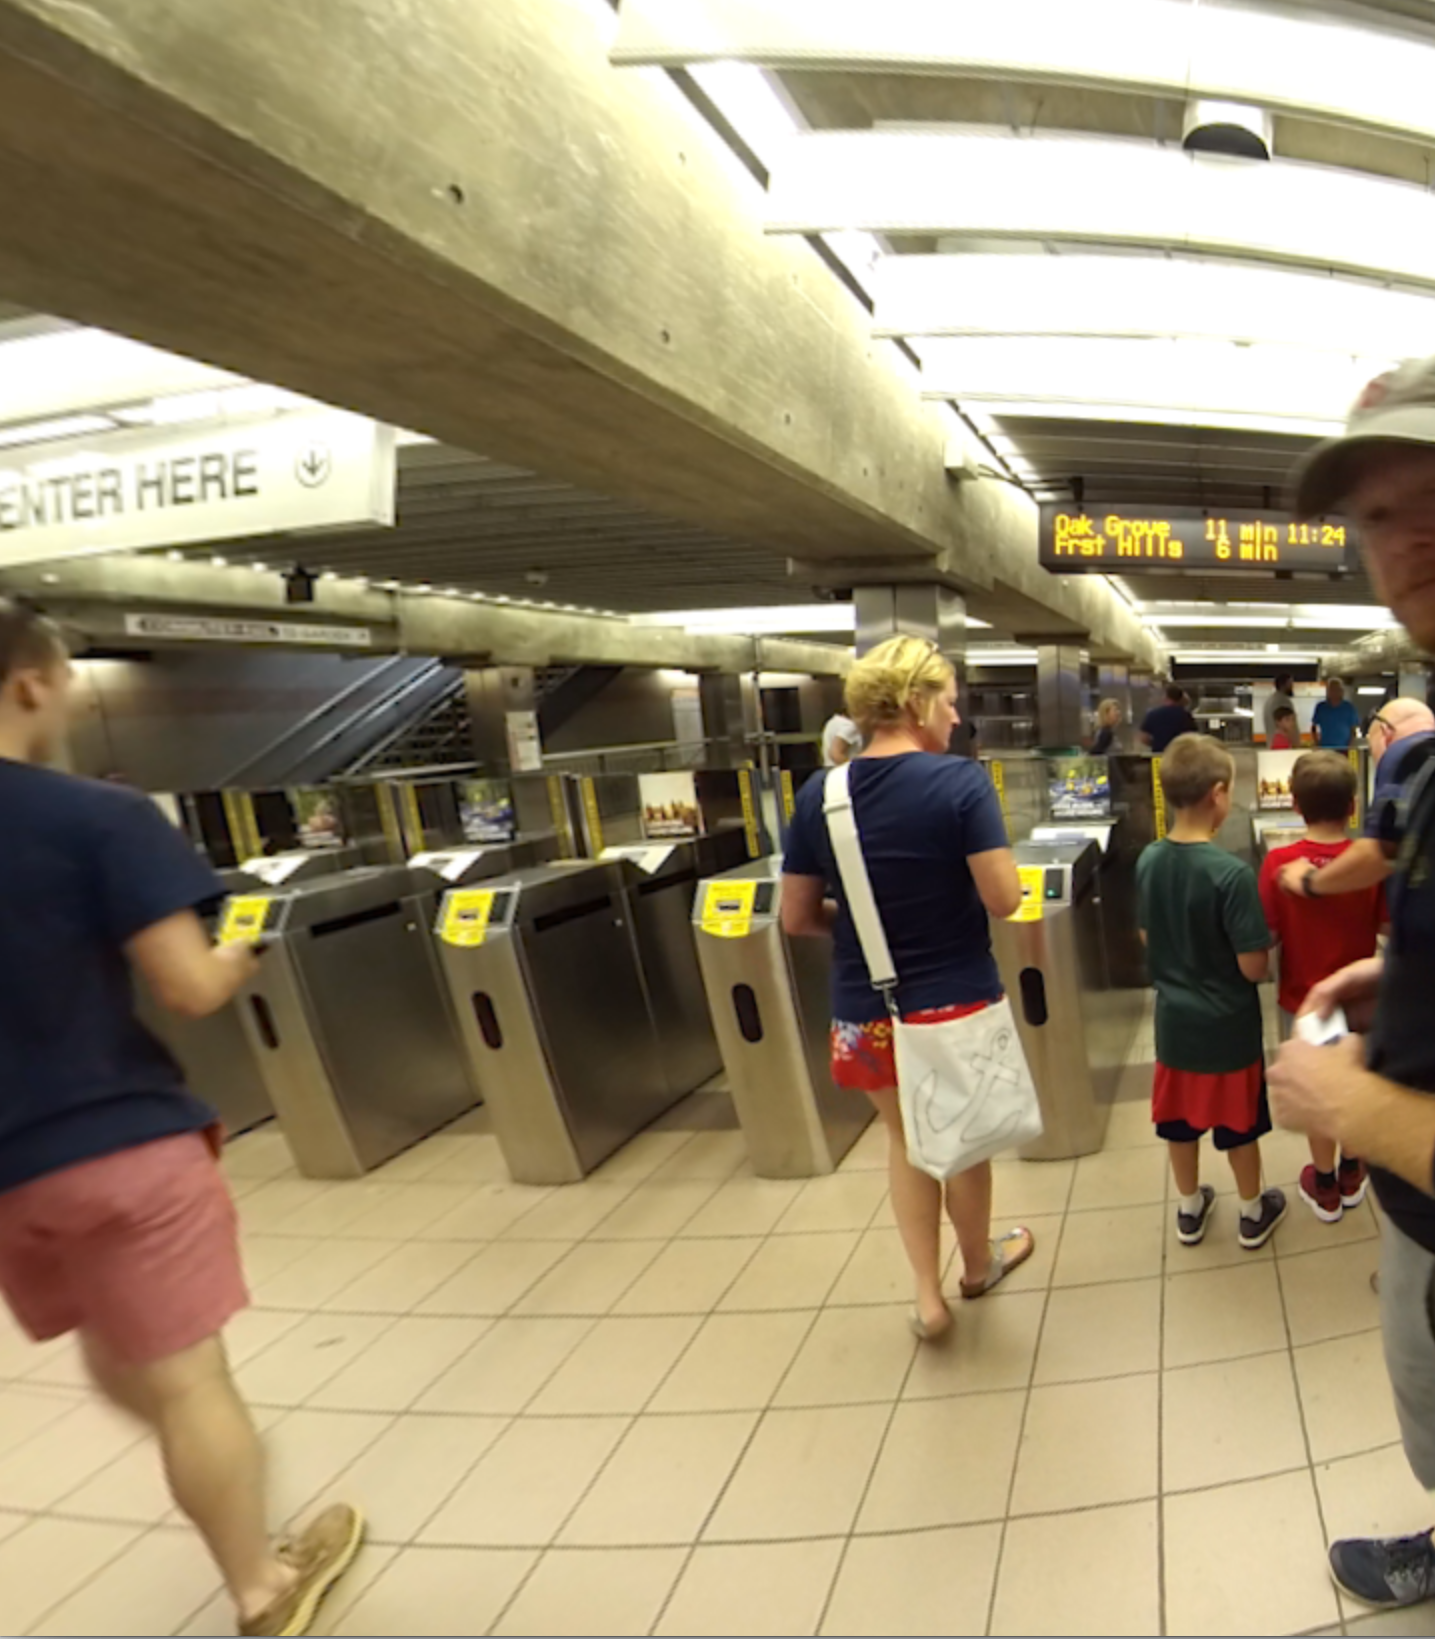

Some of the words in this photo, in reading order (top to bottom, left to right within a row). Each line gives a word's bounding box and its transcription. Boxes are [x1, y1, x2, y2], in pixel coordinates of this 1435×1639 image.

[0, 468, 124, 533] ENTER
[136, 448, 259, 512] HERE
[1054, 513, 1096, 536] Oak
[1104, 514, 1171, 538] Grove
[1205, 518, 1229, 542] 11
[1239, 520, 1279, 543] min
[1287, 522, 1346, 547] 11:24
[1054, 534, 1107, 556] Frst
[1117, 533, 1184, 559] Hills
[1215, 538, 1232, 560] 6
[1239, 541, 1279, 561] min
